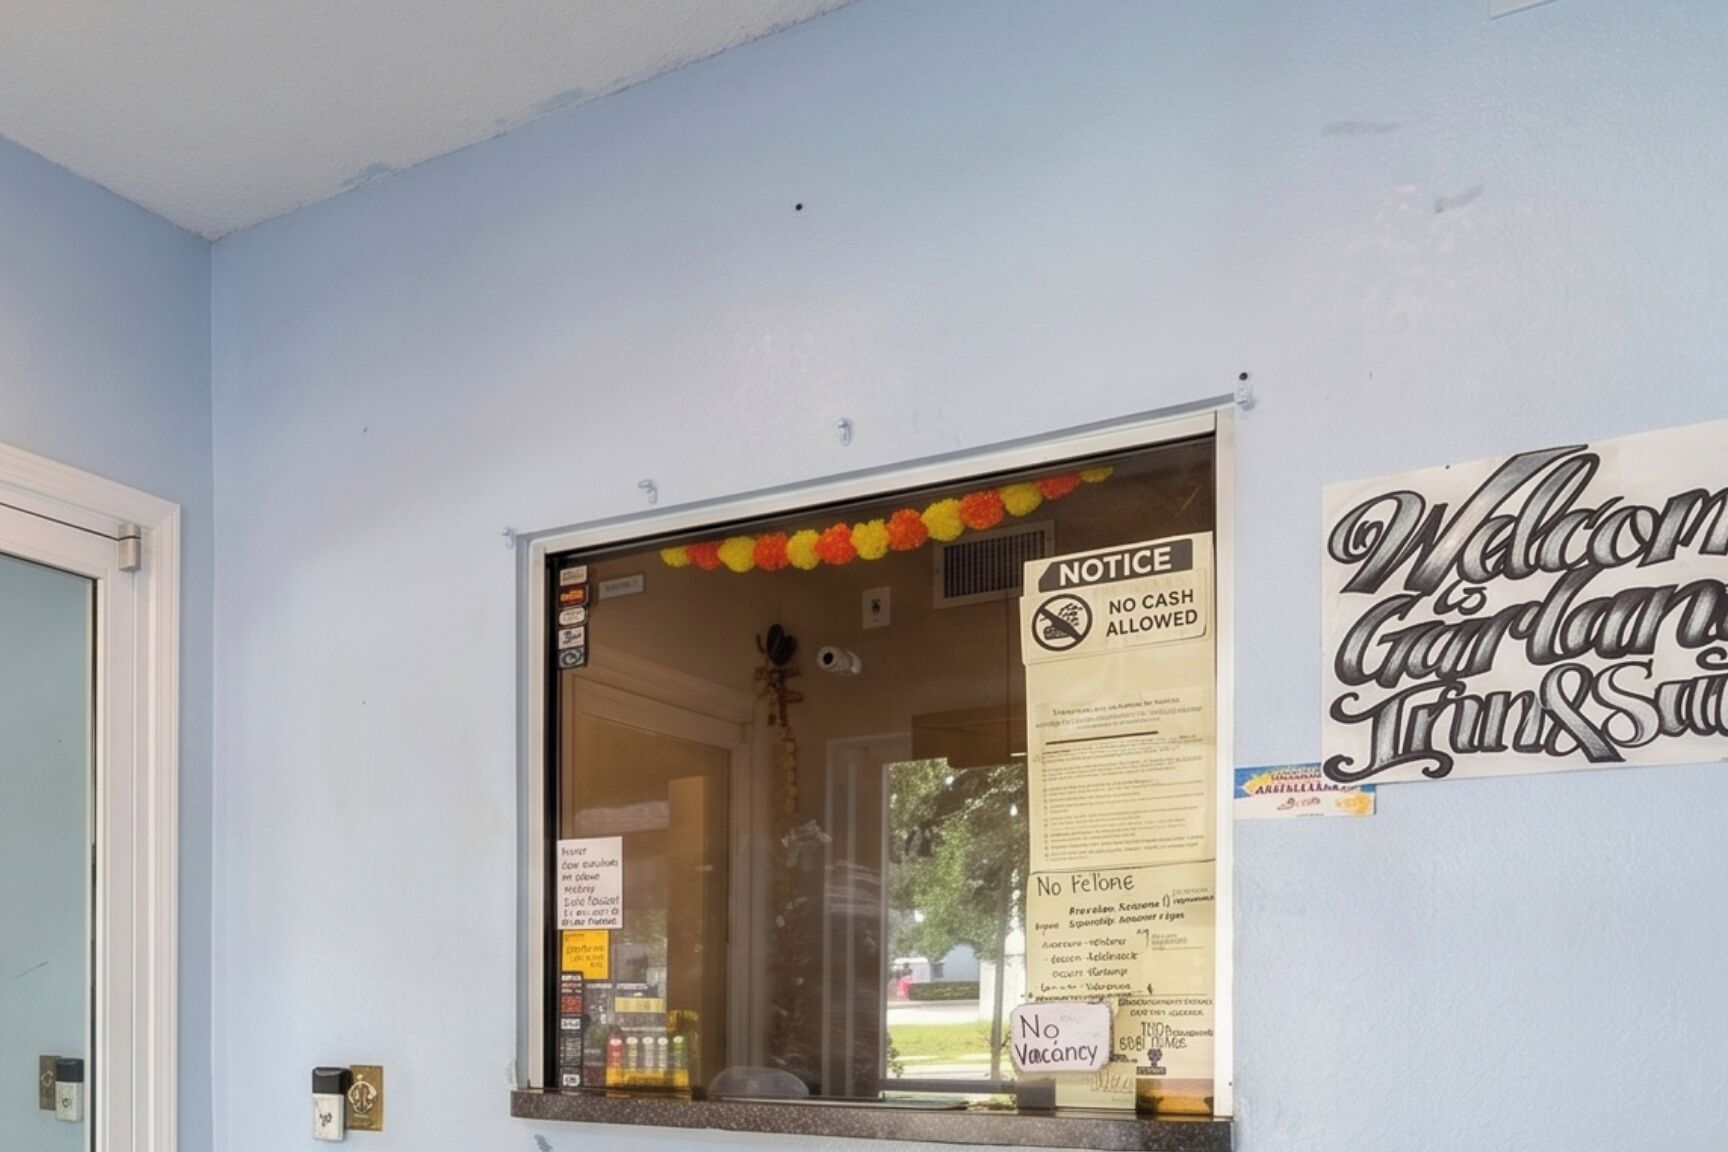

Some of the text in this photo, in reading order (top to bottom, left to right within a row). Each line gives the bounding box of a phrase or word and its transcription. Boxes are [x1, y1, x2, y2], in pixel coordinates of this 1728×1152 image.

[1059, 546, 1172, 586] NOTICE
[1109, 589, 1194, 615] NO CASH
[1106, 609, 1198, 637] ALLOWED
[1334, 565, 1728, 688] Garlan
[1037, 876, 1062, 897] No
[1020, 1014, 1059, 1040] No
[1014, 1043, 1098, 1066] Vacancy
